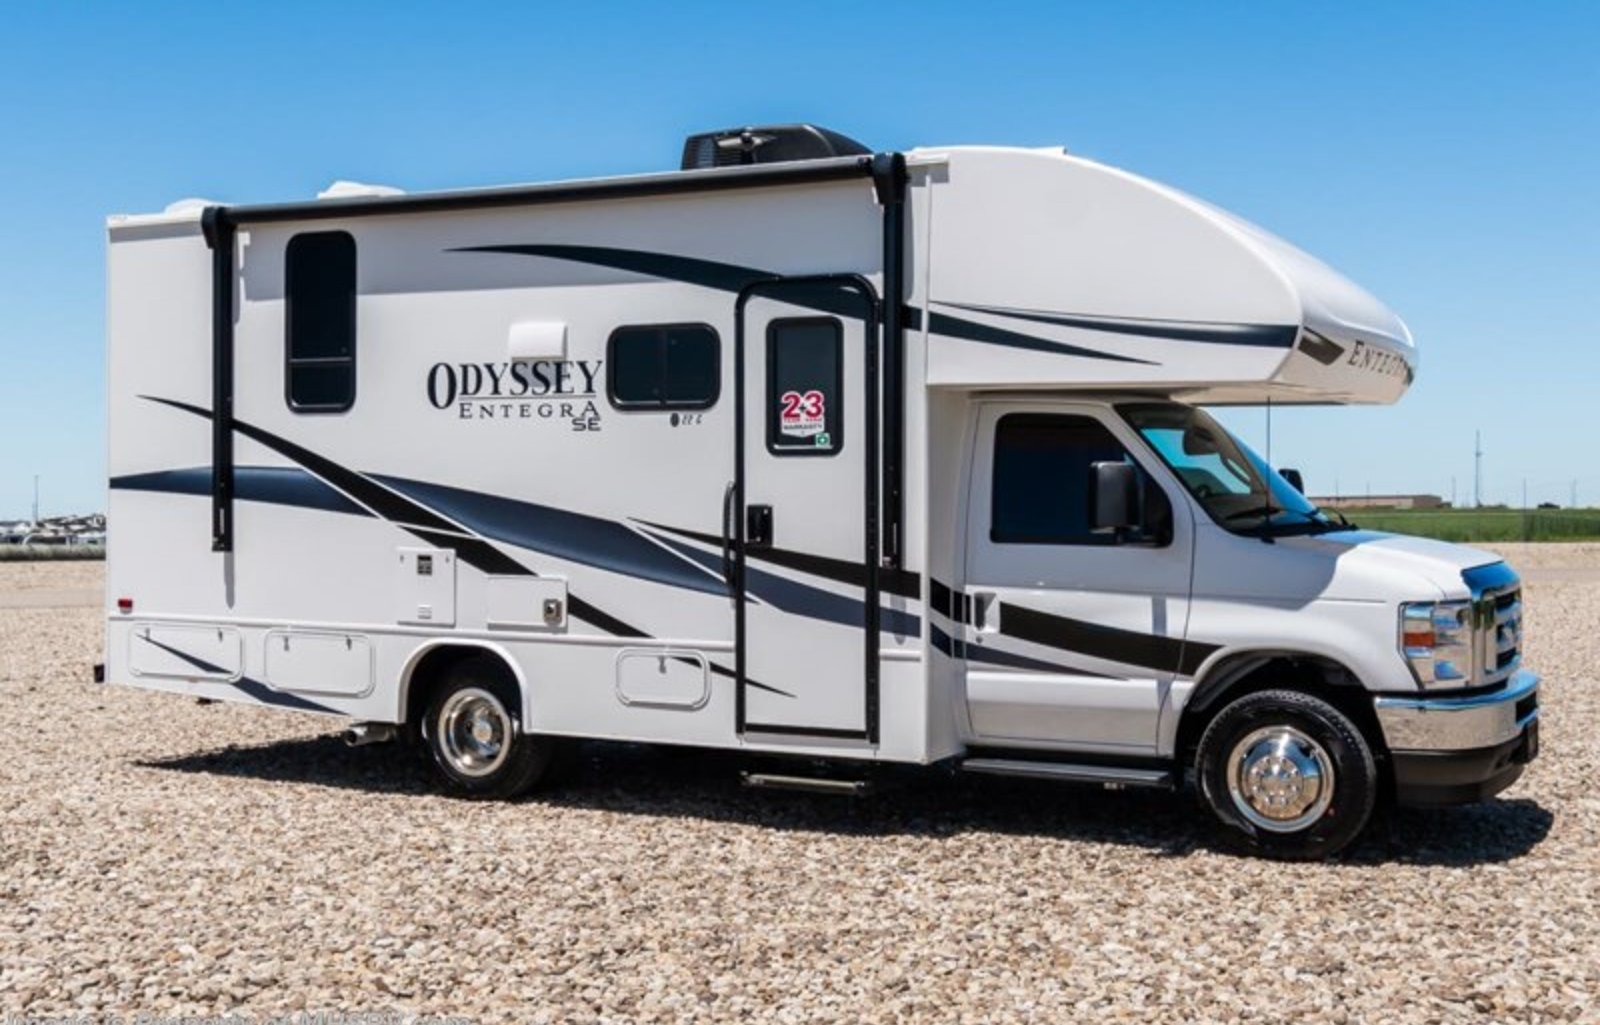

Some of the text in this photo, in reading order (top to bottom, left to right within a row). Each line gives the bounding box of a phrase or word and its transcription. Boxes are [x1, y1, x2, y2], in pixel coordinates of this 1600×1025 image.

[427, 360, 603, 410] ODYSSEY
[458, 401, 600, 419] ENTEGRA
[572, 419, 602, 432] SE
